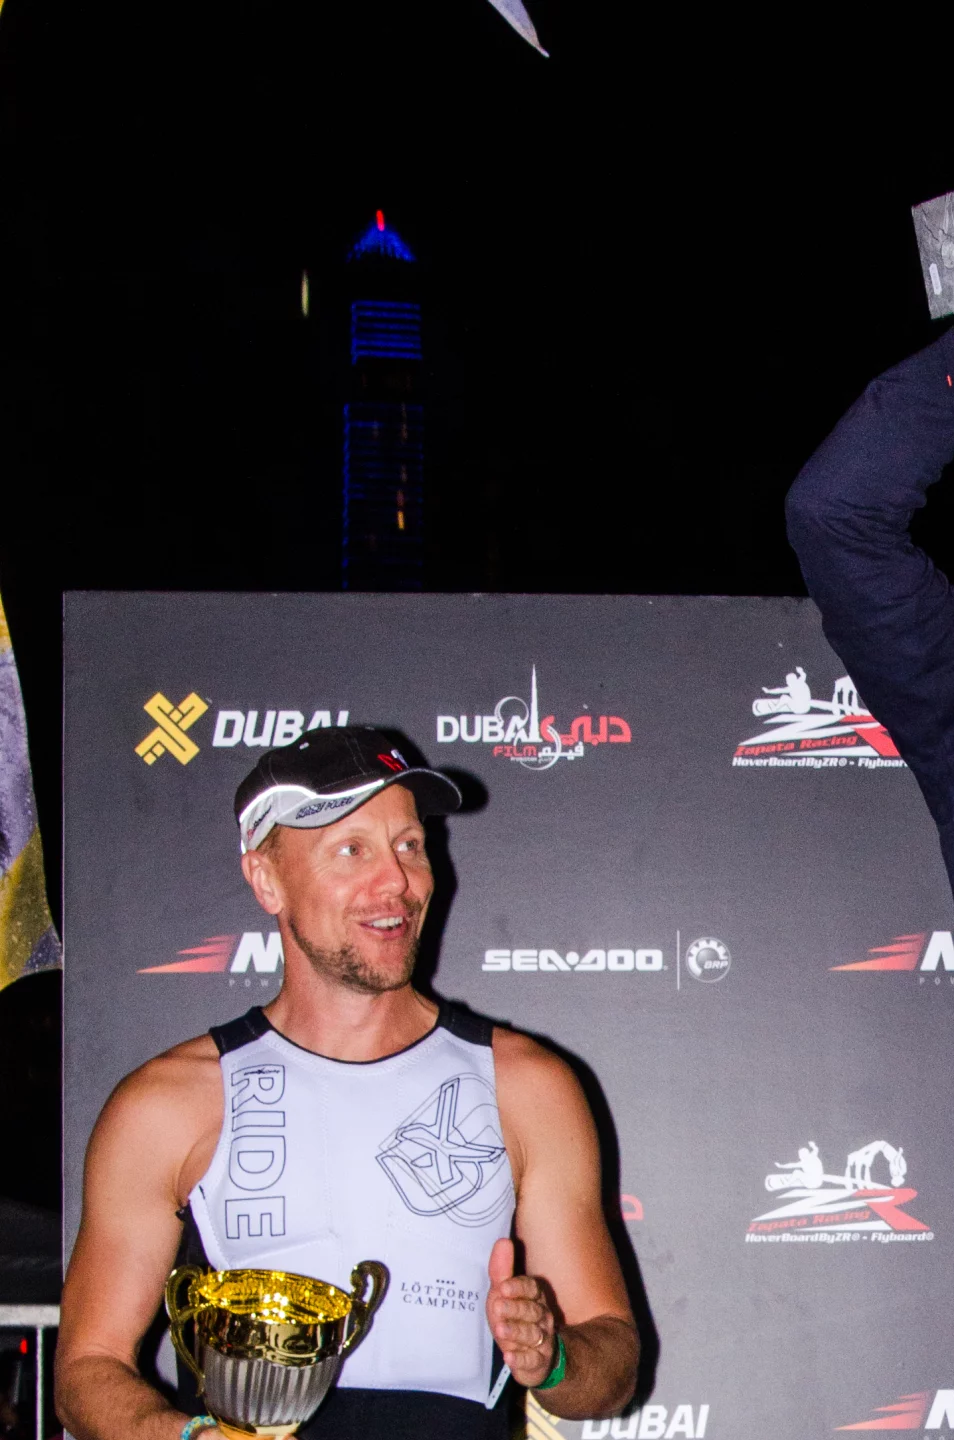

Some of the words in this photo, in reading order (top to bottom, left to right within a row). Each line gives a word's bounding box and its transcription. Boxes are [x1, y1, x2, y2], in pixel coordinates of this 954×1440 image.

[225, 1064, 286, 1239] RIDE
[401, 1281, 480, 1300] LÖTTORPS
[403, 1294, 475, 1312] CAMPING
